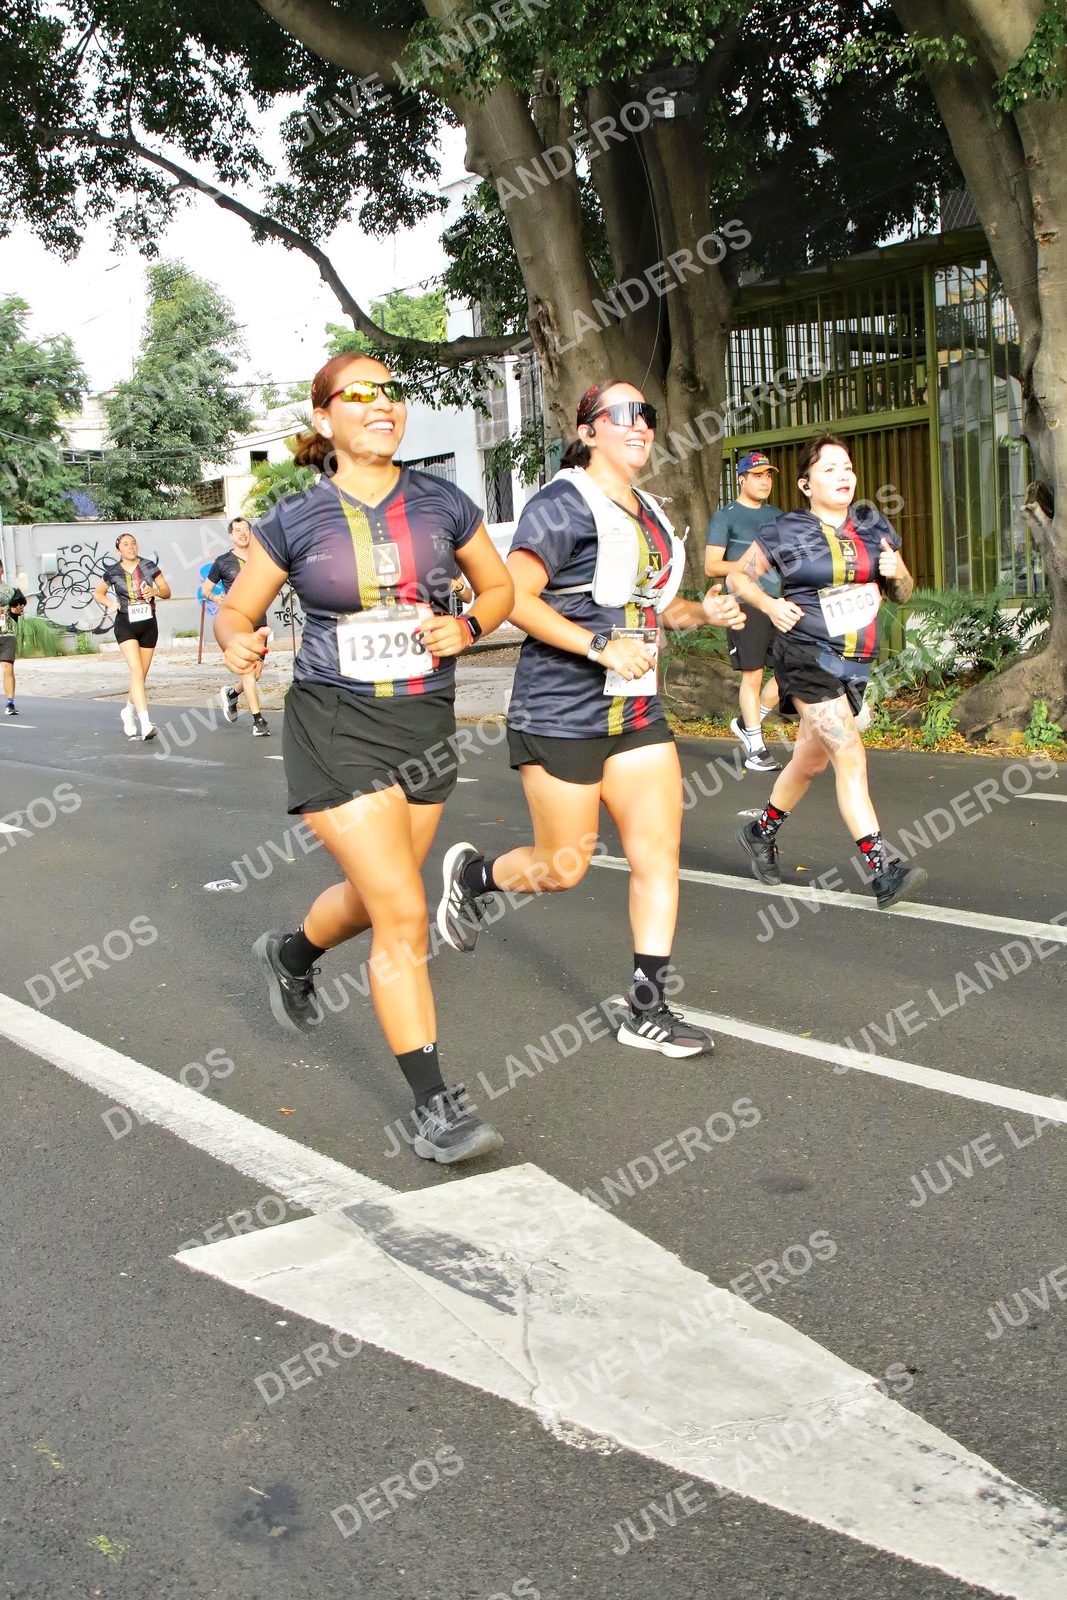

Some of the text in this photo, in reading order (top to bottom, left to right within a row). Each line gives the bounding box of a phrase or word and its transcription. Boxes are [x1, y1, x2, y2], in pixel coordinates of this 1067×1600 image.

[57, 541, 99, 558] TOY
[826, 592, 875, 618] 11360
[345, 631, 426, 661] 13298
